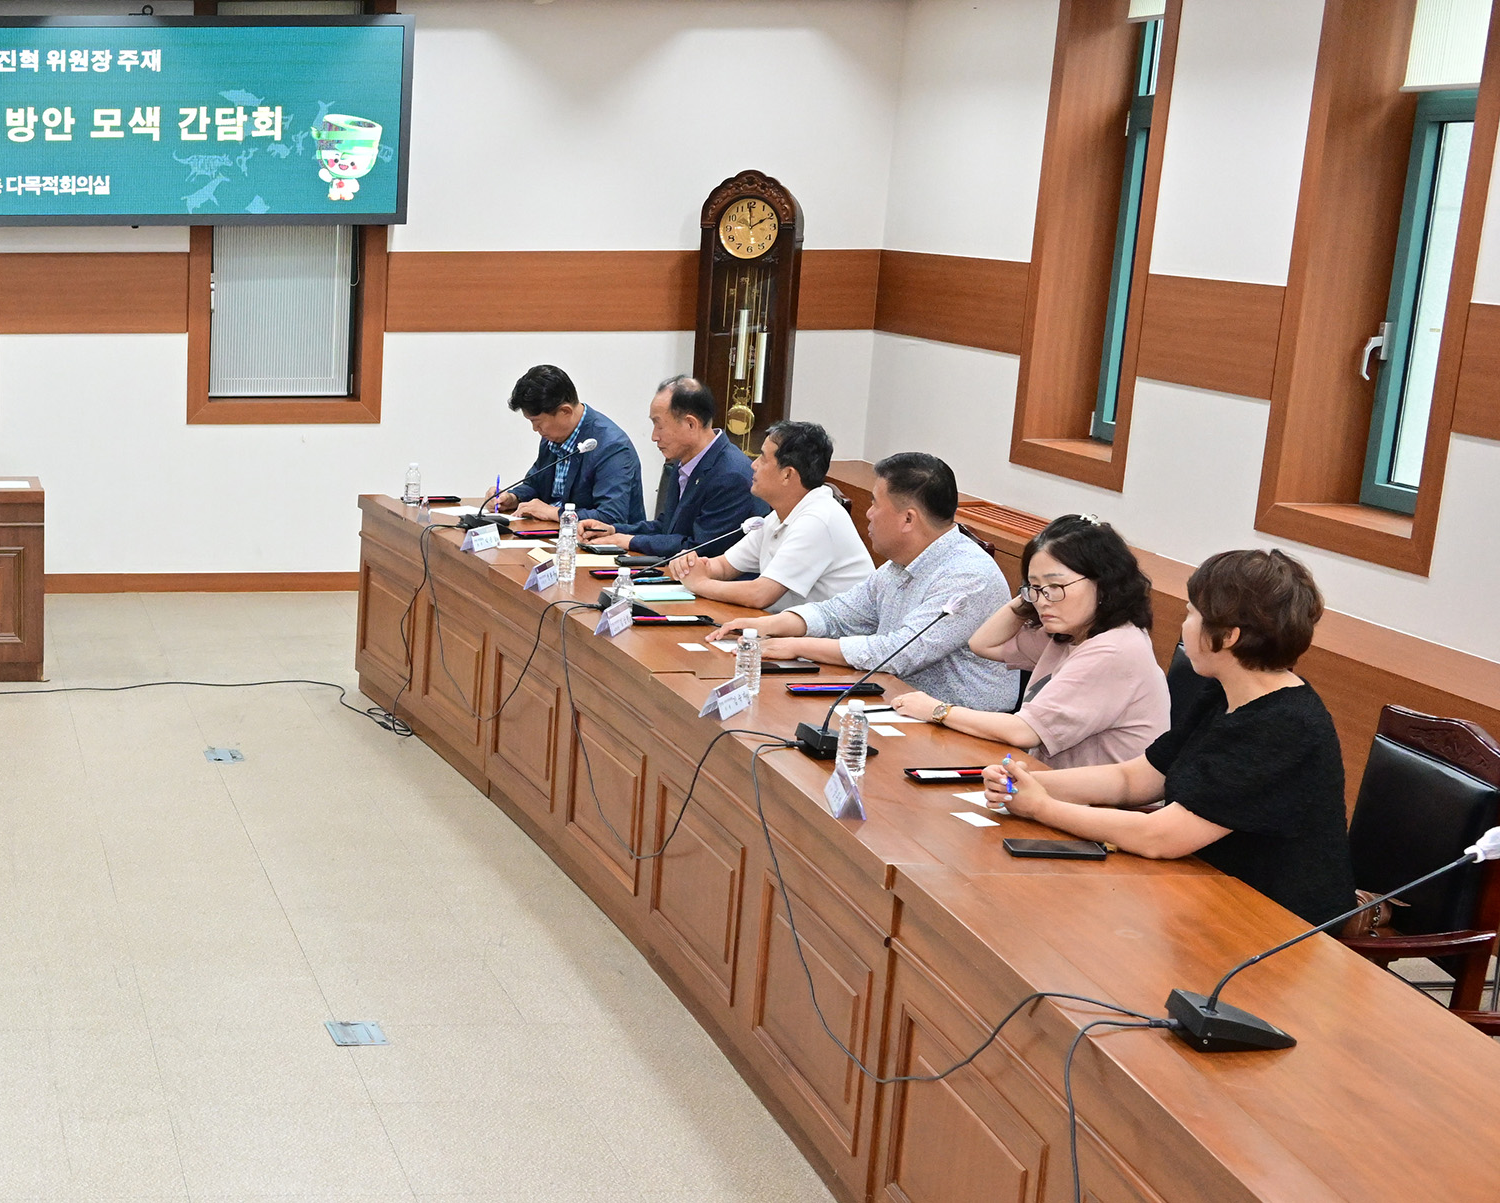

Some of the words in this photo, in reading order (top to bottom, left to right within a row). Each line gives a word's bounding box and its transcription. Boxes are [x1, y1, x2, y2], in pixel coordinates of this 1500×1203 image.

[46, 49, 113, 73] 위원장
[116, 49, 162, 73] 주재
[5, 106, 76, 143] 방안
[90, 106, 161, 142] 모색
[178, 105, 283, 142] 간담회
[6, 176, 111, 196] 다목적회의실
[728, 214, 737, 222] 10
[767, 212, 774, 220] 2
[770, 223, 777, 231] 3
[757, 242, 765, 250] 5
